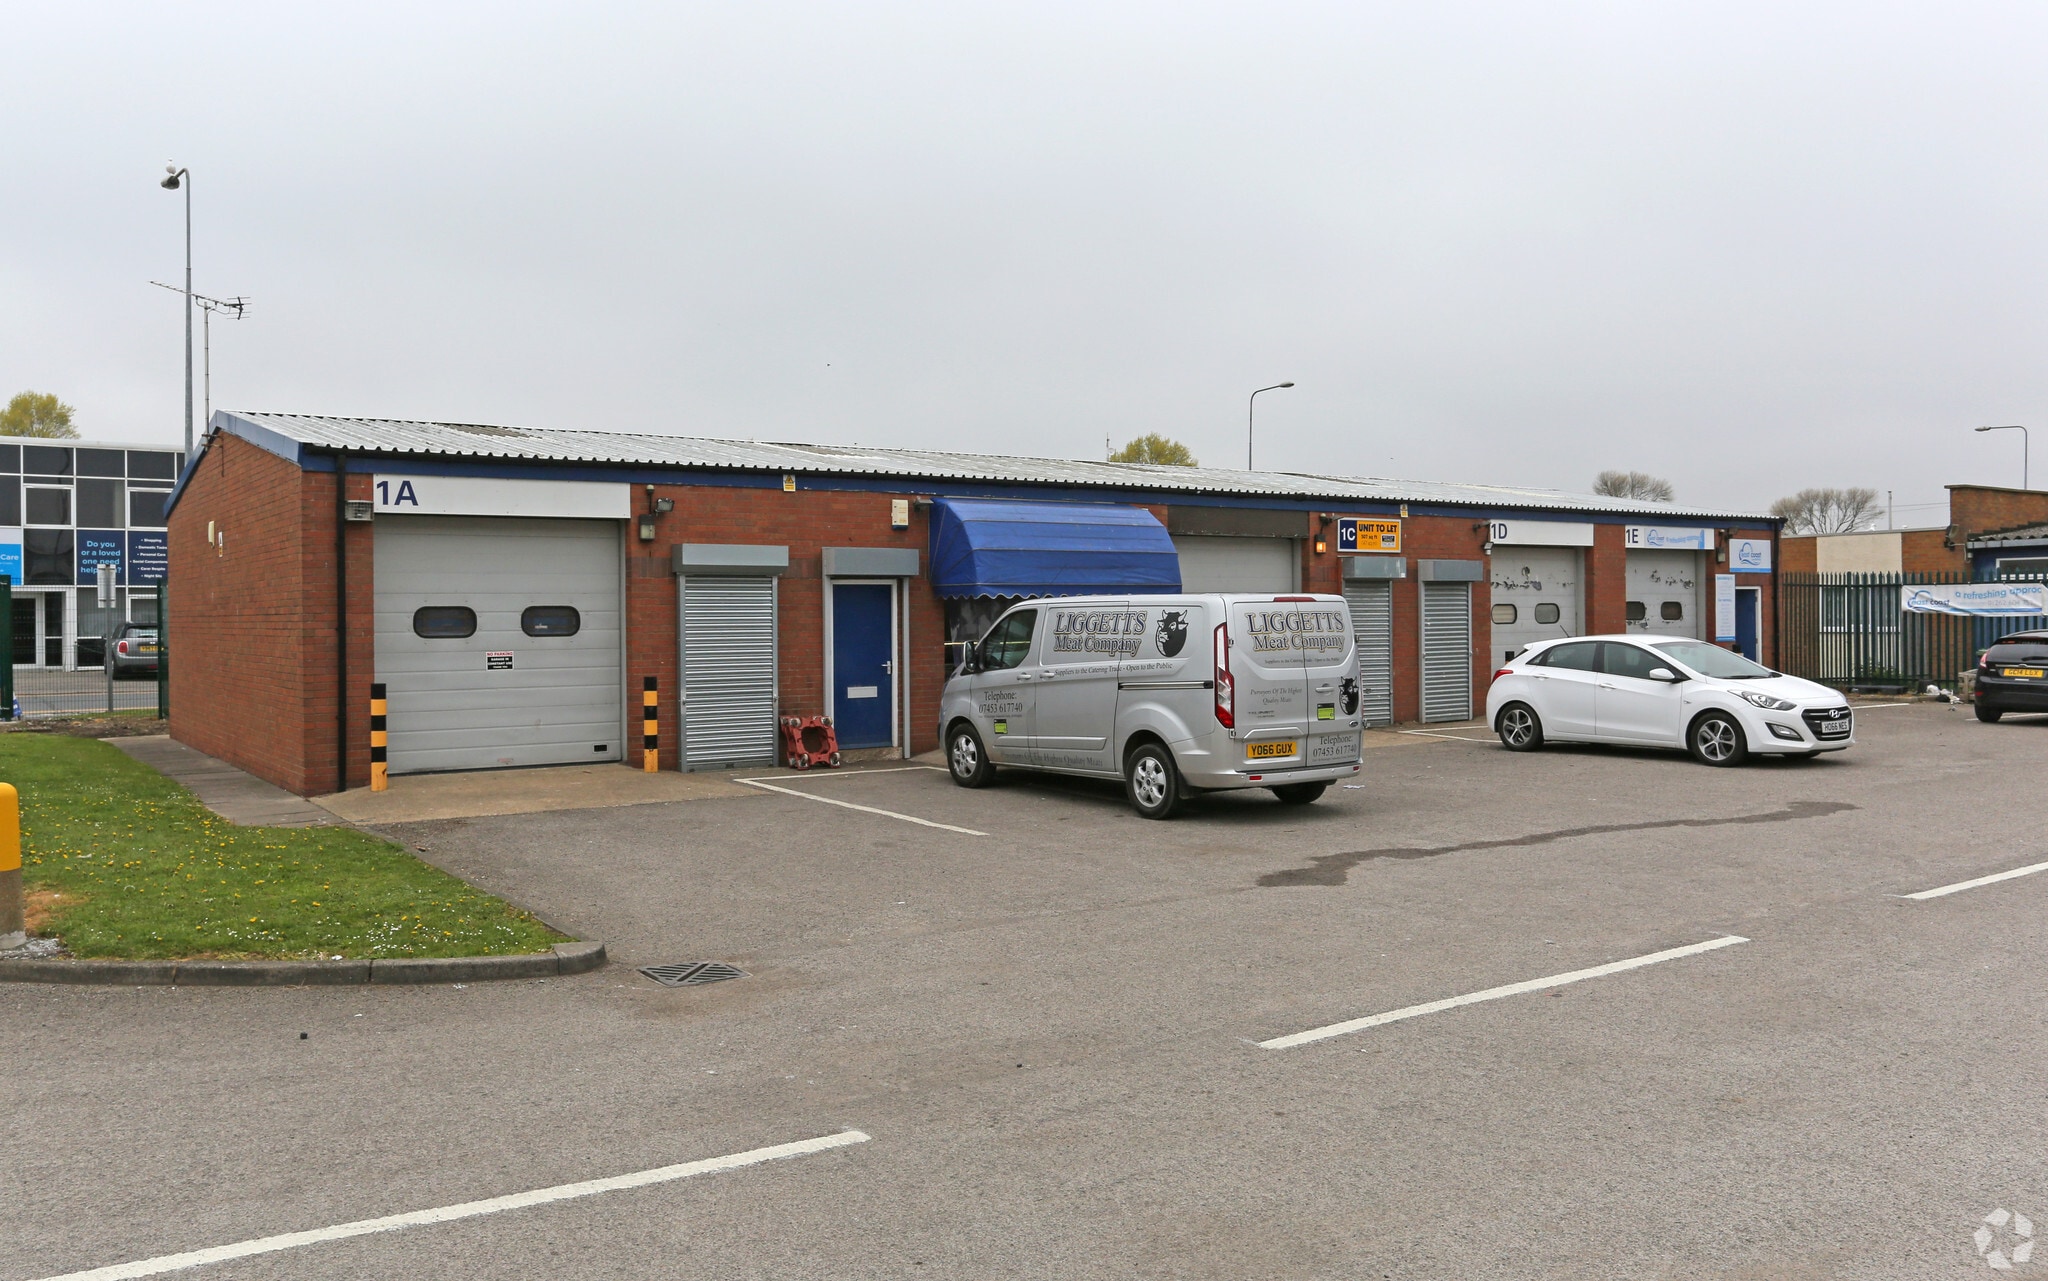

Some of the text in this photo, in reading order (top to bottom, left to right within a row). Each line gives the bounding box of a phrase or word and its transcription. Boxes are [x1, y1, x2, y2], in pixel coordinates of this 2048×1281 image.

[376, 480, 419, 506] 1A
[1341, 528, 1356, 541] 1C
[1359, 524, 1374, 532] UNIT
[1491, 523, 1508, 539] 1D
[1626, 529, 1638, 544] 1E
[1964, 590, 2007, 599] refreshing
[1054, 610, 1147, 635] LIGGETTS
[1245, 610, 1345, 635] LIGGETTS
[1054, 634, 1142, 657] Meat Company
[1252, 633, 1345, 653] Meat Company
[984, 691, 1017, 702] Telephone:
[979, 702, 1023, 713] 07453 617740
[1251, 743, 1293, 756] YO66 GUX
[1313, 744, 1357, 758] 07453 617740
